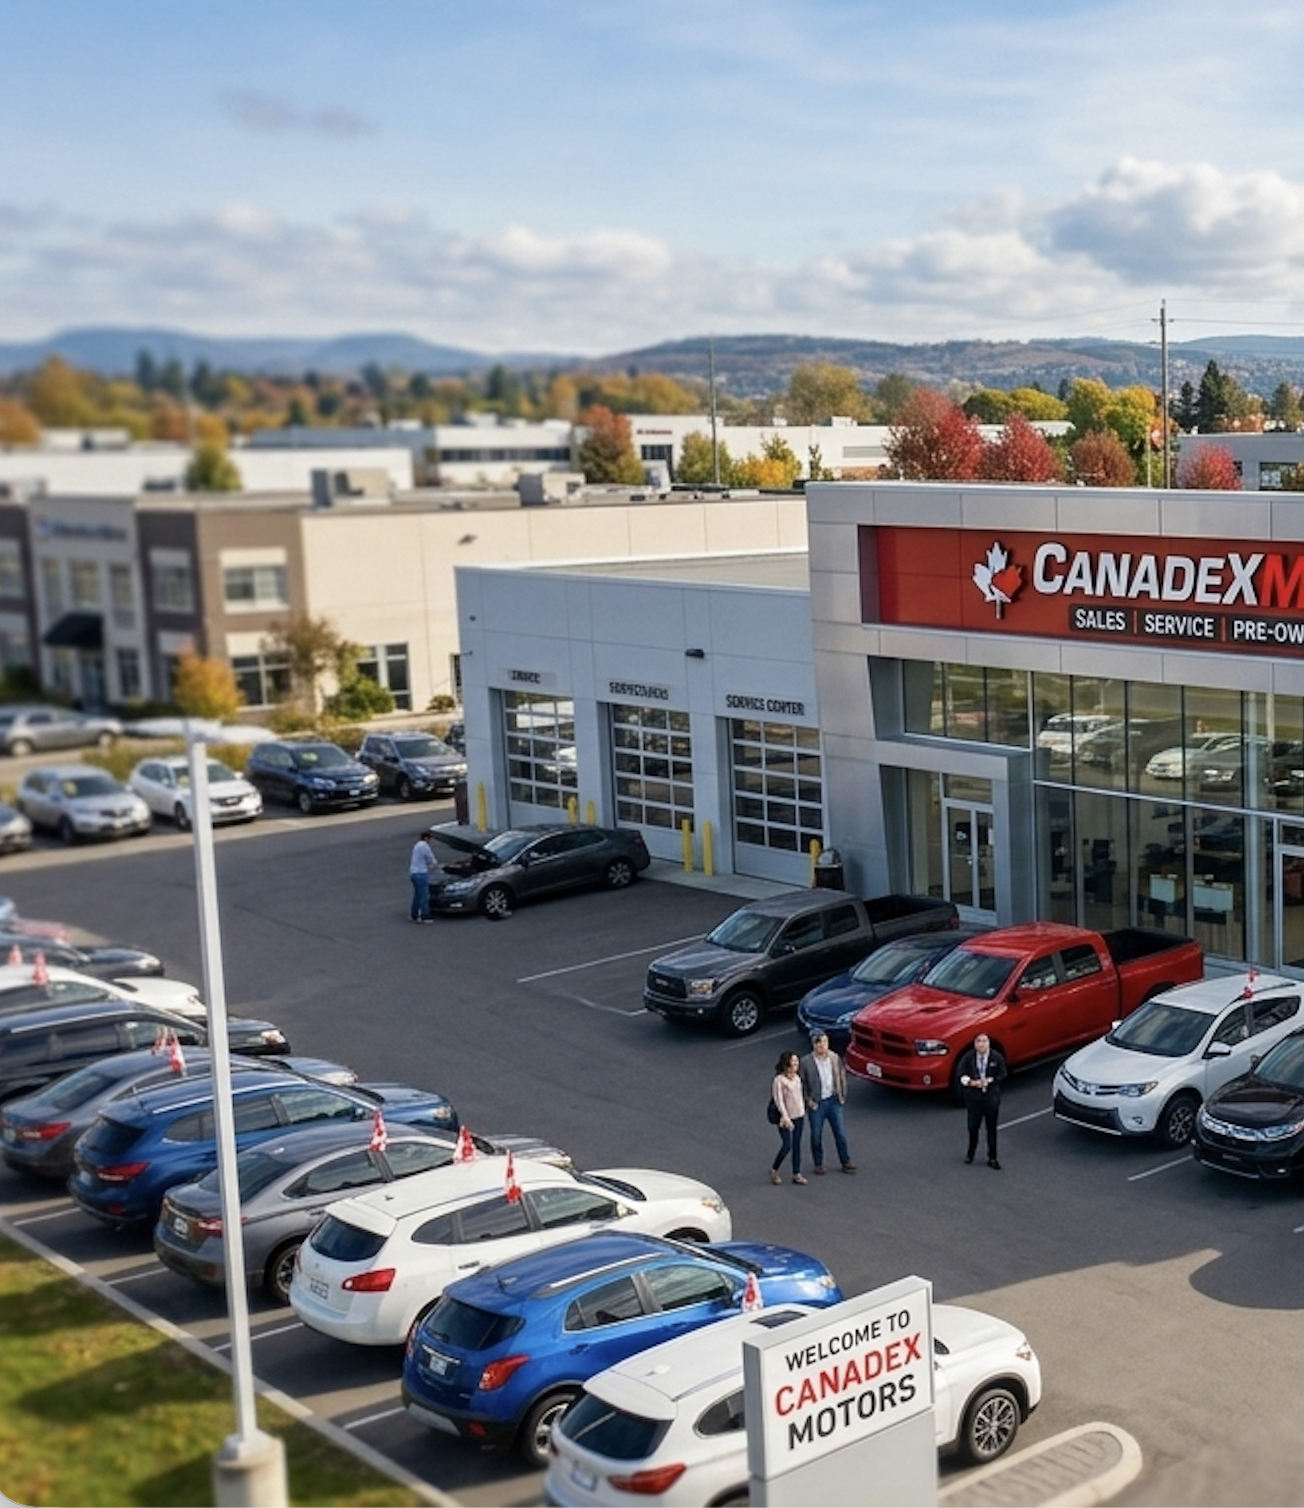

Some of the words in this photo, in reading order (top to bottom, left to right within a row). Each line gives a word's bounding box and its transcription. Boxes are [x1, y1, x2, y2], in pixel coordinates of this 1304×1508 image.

[1074, 608, 1126, 631] SALES
[1143, 613, 1215, 638] SERVICE
[774, 1331, 922, 1417] CANADEX
[785, 1319, 881, 1373] WELCOME
[886, 1309, 911, 1332] TO
[788, 1373, 917, 1451] MOTORS
